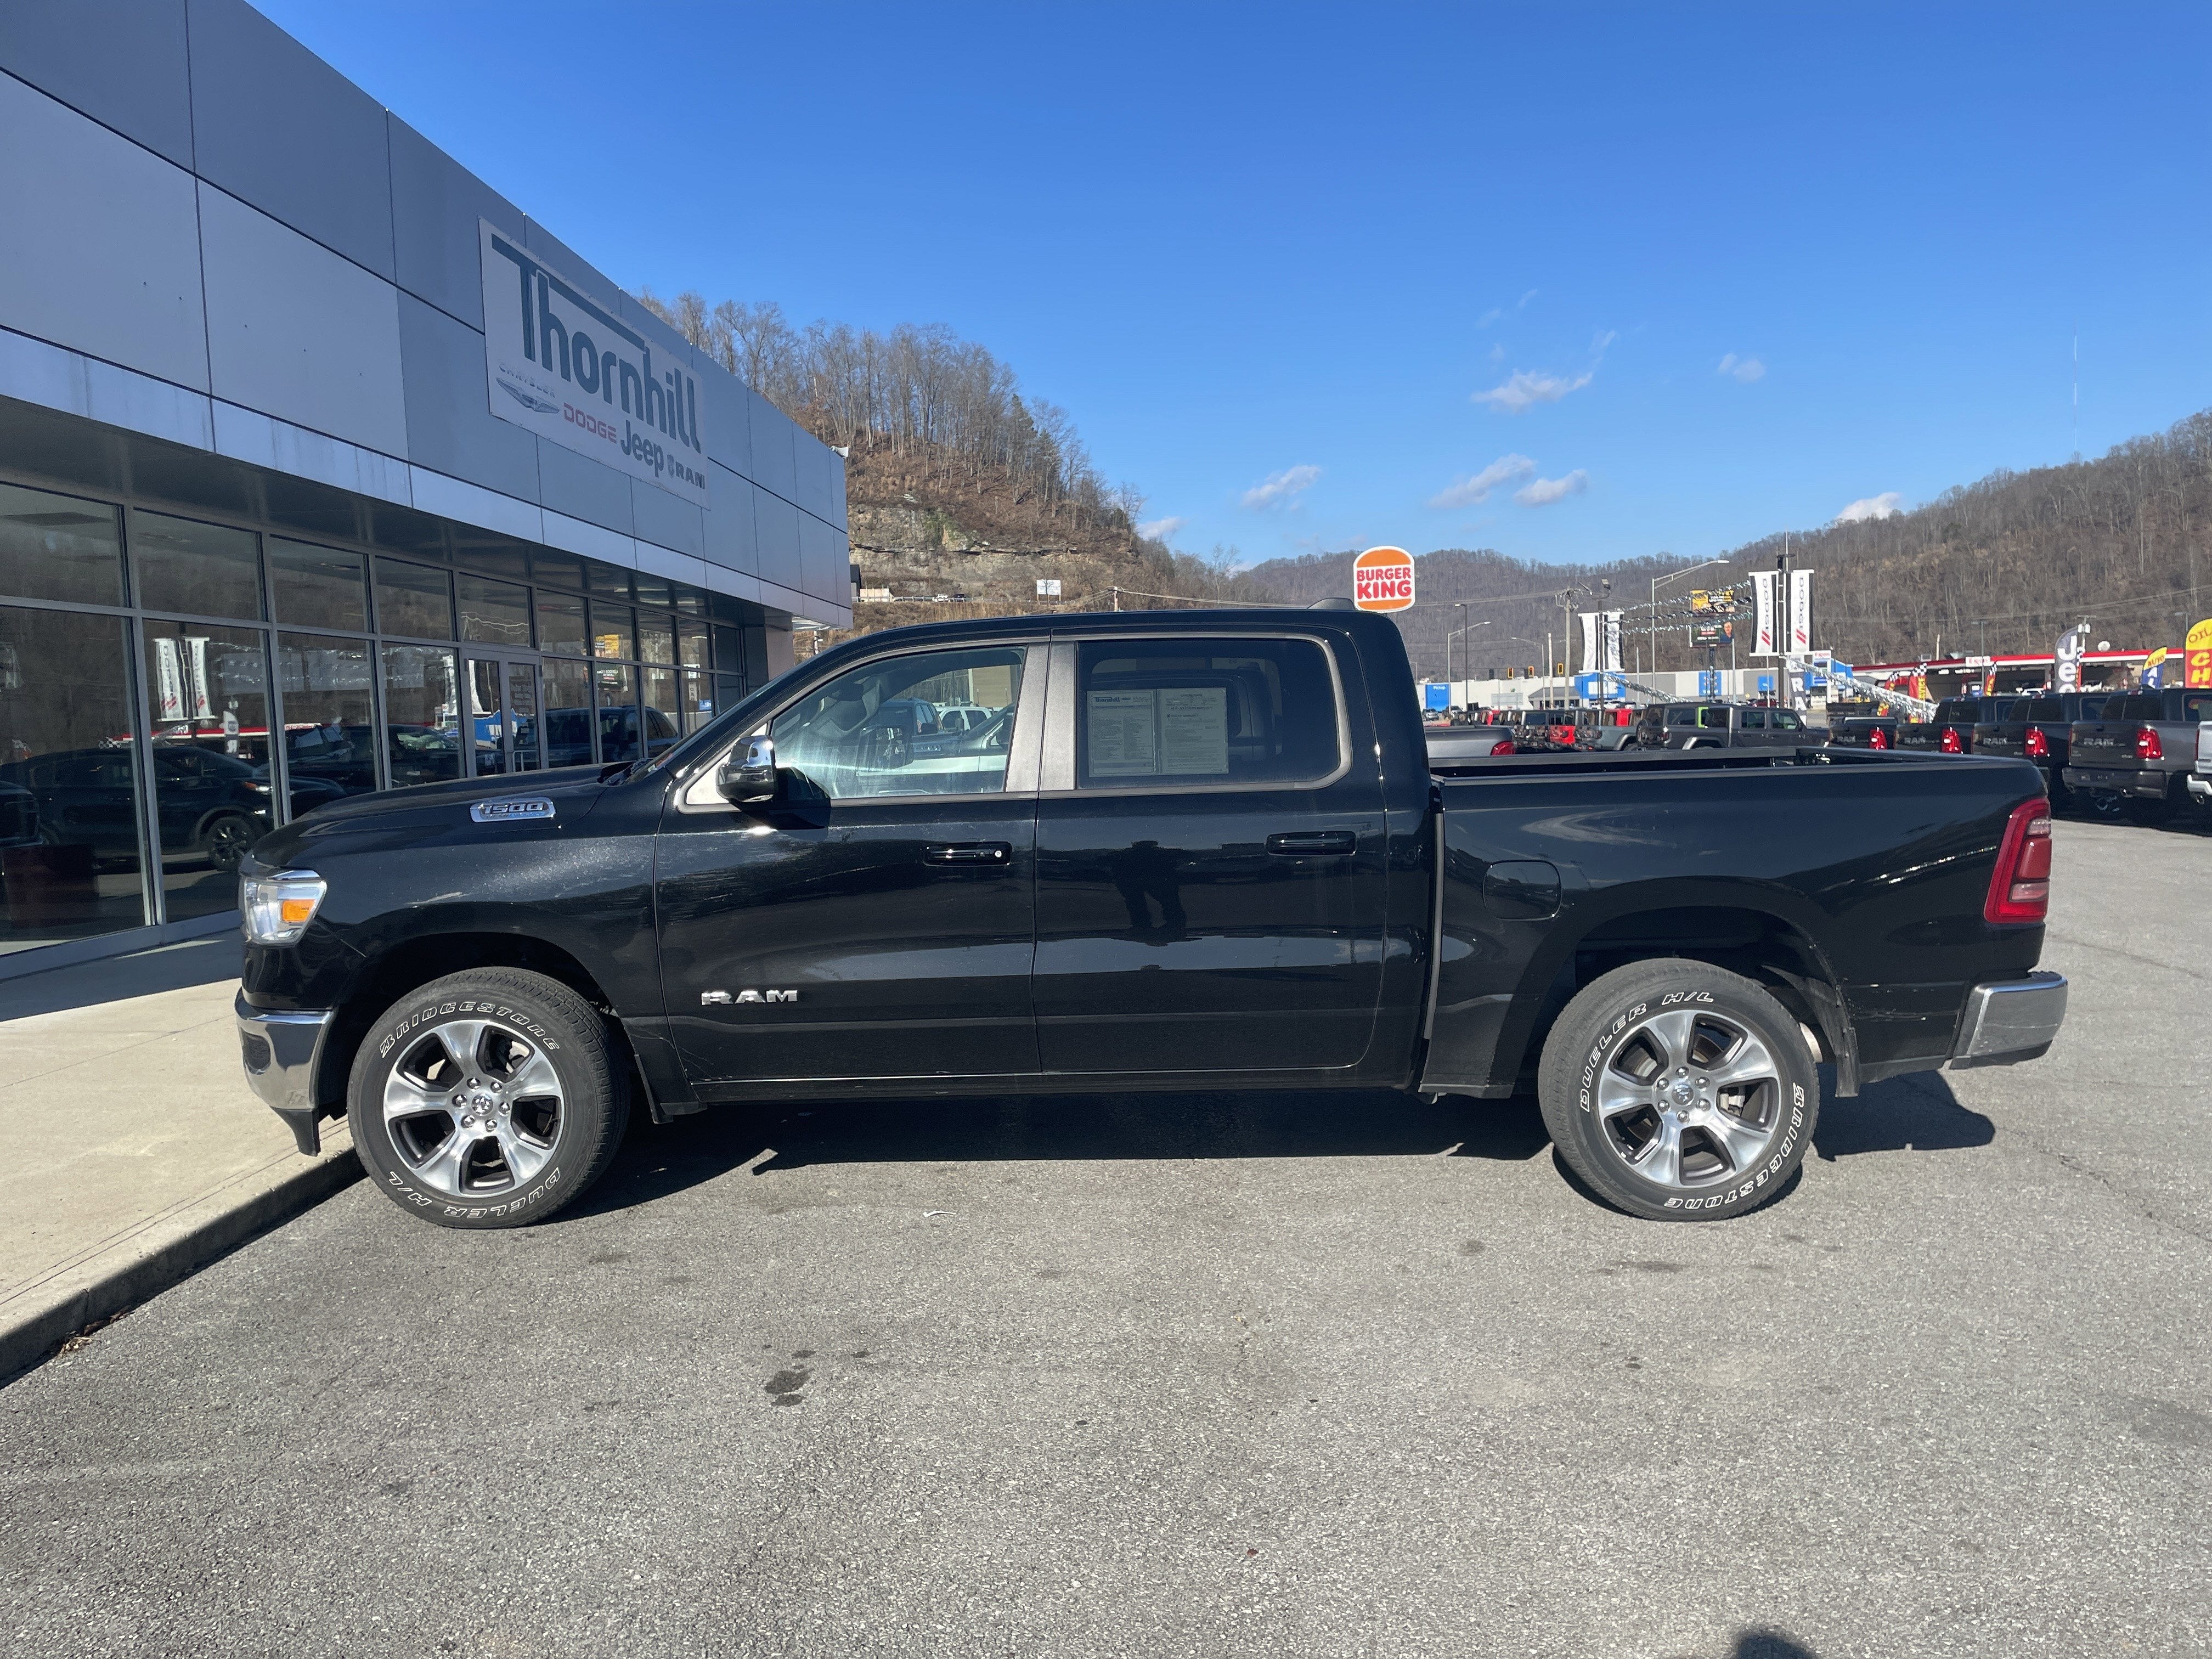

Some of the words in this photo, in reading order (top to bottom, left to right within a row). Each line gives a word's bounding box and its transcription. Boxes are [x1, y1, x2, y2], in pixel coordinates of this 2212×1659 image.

[491, 233, 701, 454] Thornhill
[563, 402, 617, 444] DODGE
[620, 420, 664, 478] Jeep
[675, 461, 706, 489] RAM
[1357, 567, 1412, 582] BURGER
[1357, 580, 1412, 600] KING
[2191, 652, 2211, 689] CH
[484, 803, 544, 815] 1500
[701, 989, 798, 1006] RAM
[379, 1001, 560, 1058] BRIDGESTONE
[1580, 1003, 1646, 1112] DUELER
[1661, 991, 1714, 1006] H/L
[1664, 1082, 1805, 1210] BRIDGESTONE
[388, 1171, 433, 1207] H/L
[444, 1167, 562, 1219] DUELER
